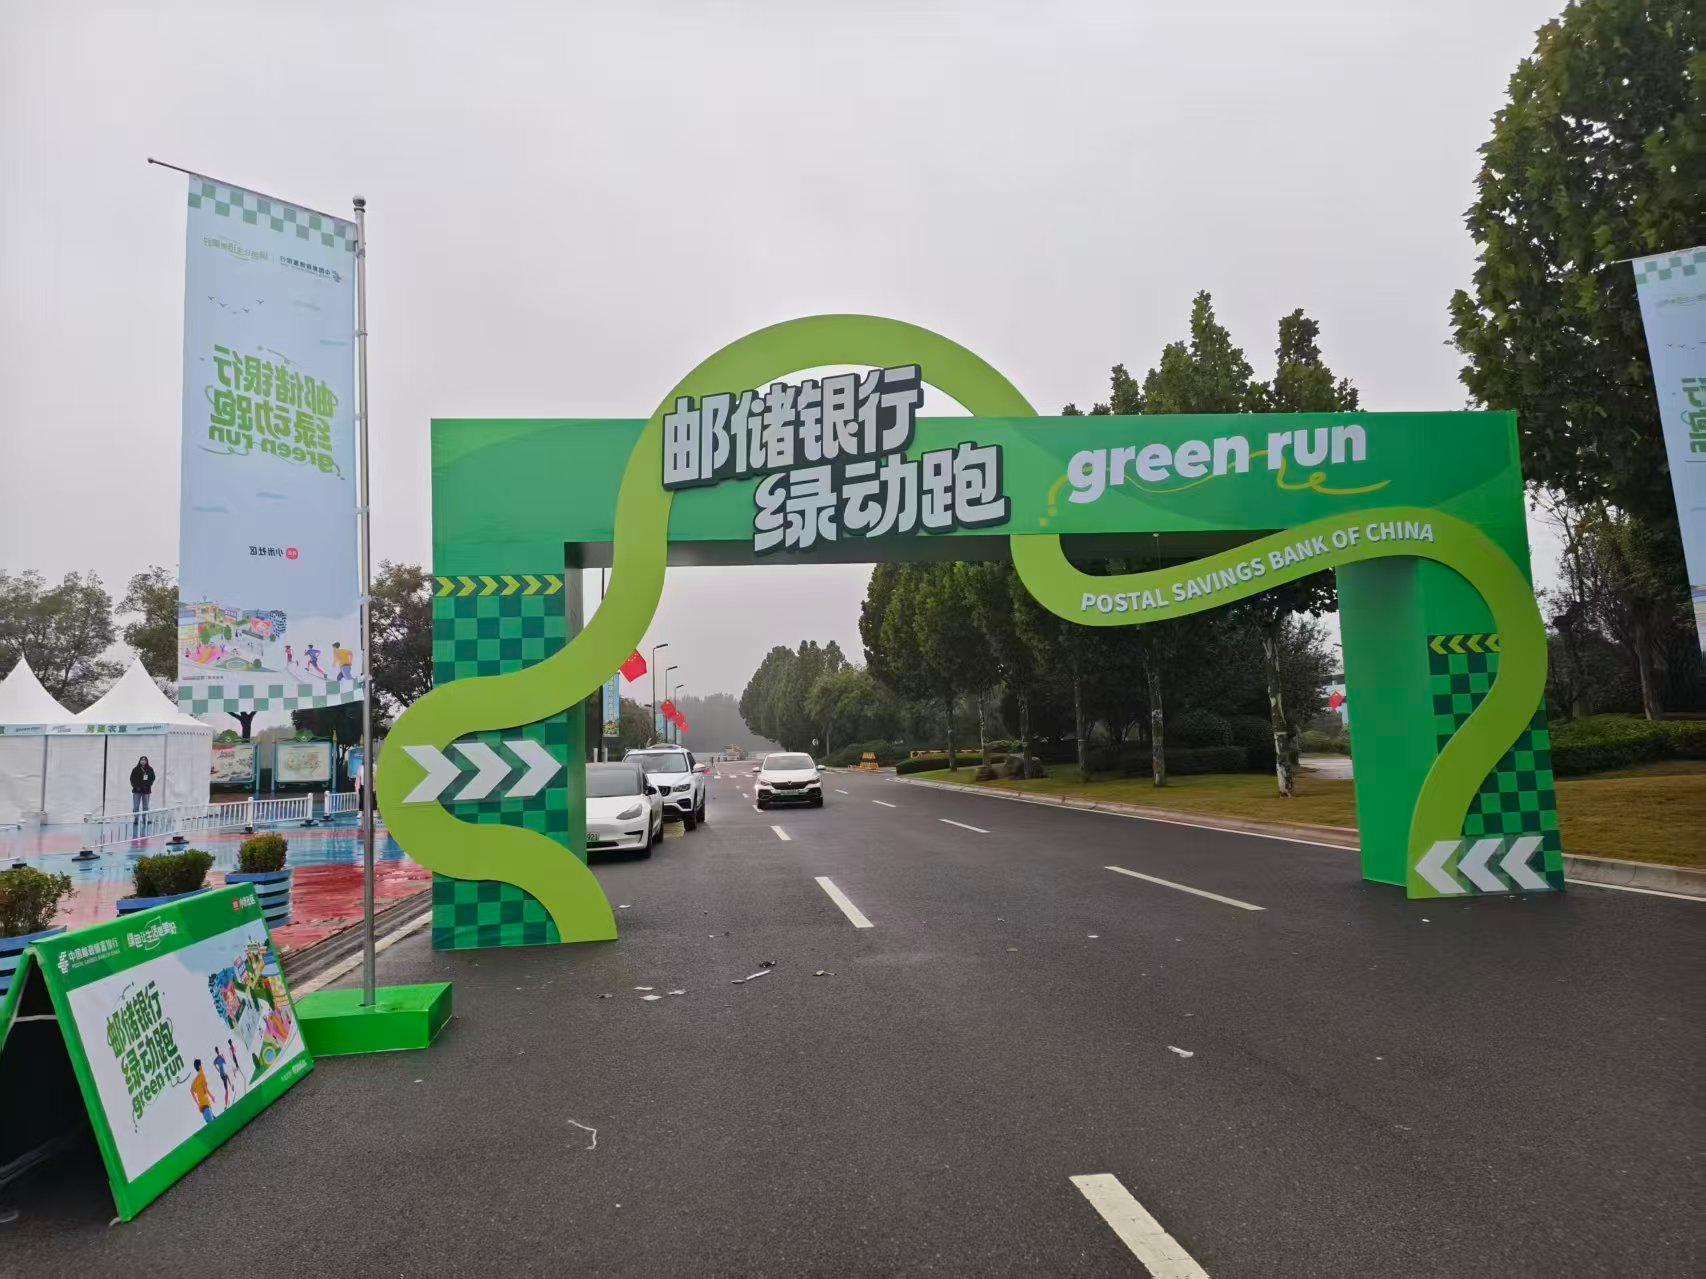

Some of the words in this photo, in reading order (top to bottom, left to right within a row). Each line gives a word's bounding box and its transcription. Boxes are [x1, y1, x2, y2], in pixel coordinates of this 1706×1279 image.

[663, 365, 922, 489] 邮储银行
[1068, 435, 1250, 504] green
[1267, 424, 1367, 470] run
[753, 443, 1009, 553] 绿动跑
[1081, 588, 1170, 614] POSTAL
[1171, 557, 1267, 602] SAVINGS
[1270, 535, 1330, 571] BANK
[1331, 526, 1361, 550] OF
[1365, 520, 1436, 543] CHINA
[68, 937, 119, 963] 中国邮政储蓄银行
[106, 980, 162, 1058] 邮储银行
[121, 1021, 179, 1095] 绿动跑
[132, 1072, 165, 1120] green
[164, 1054, 185, 1081] run
